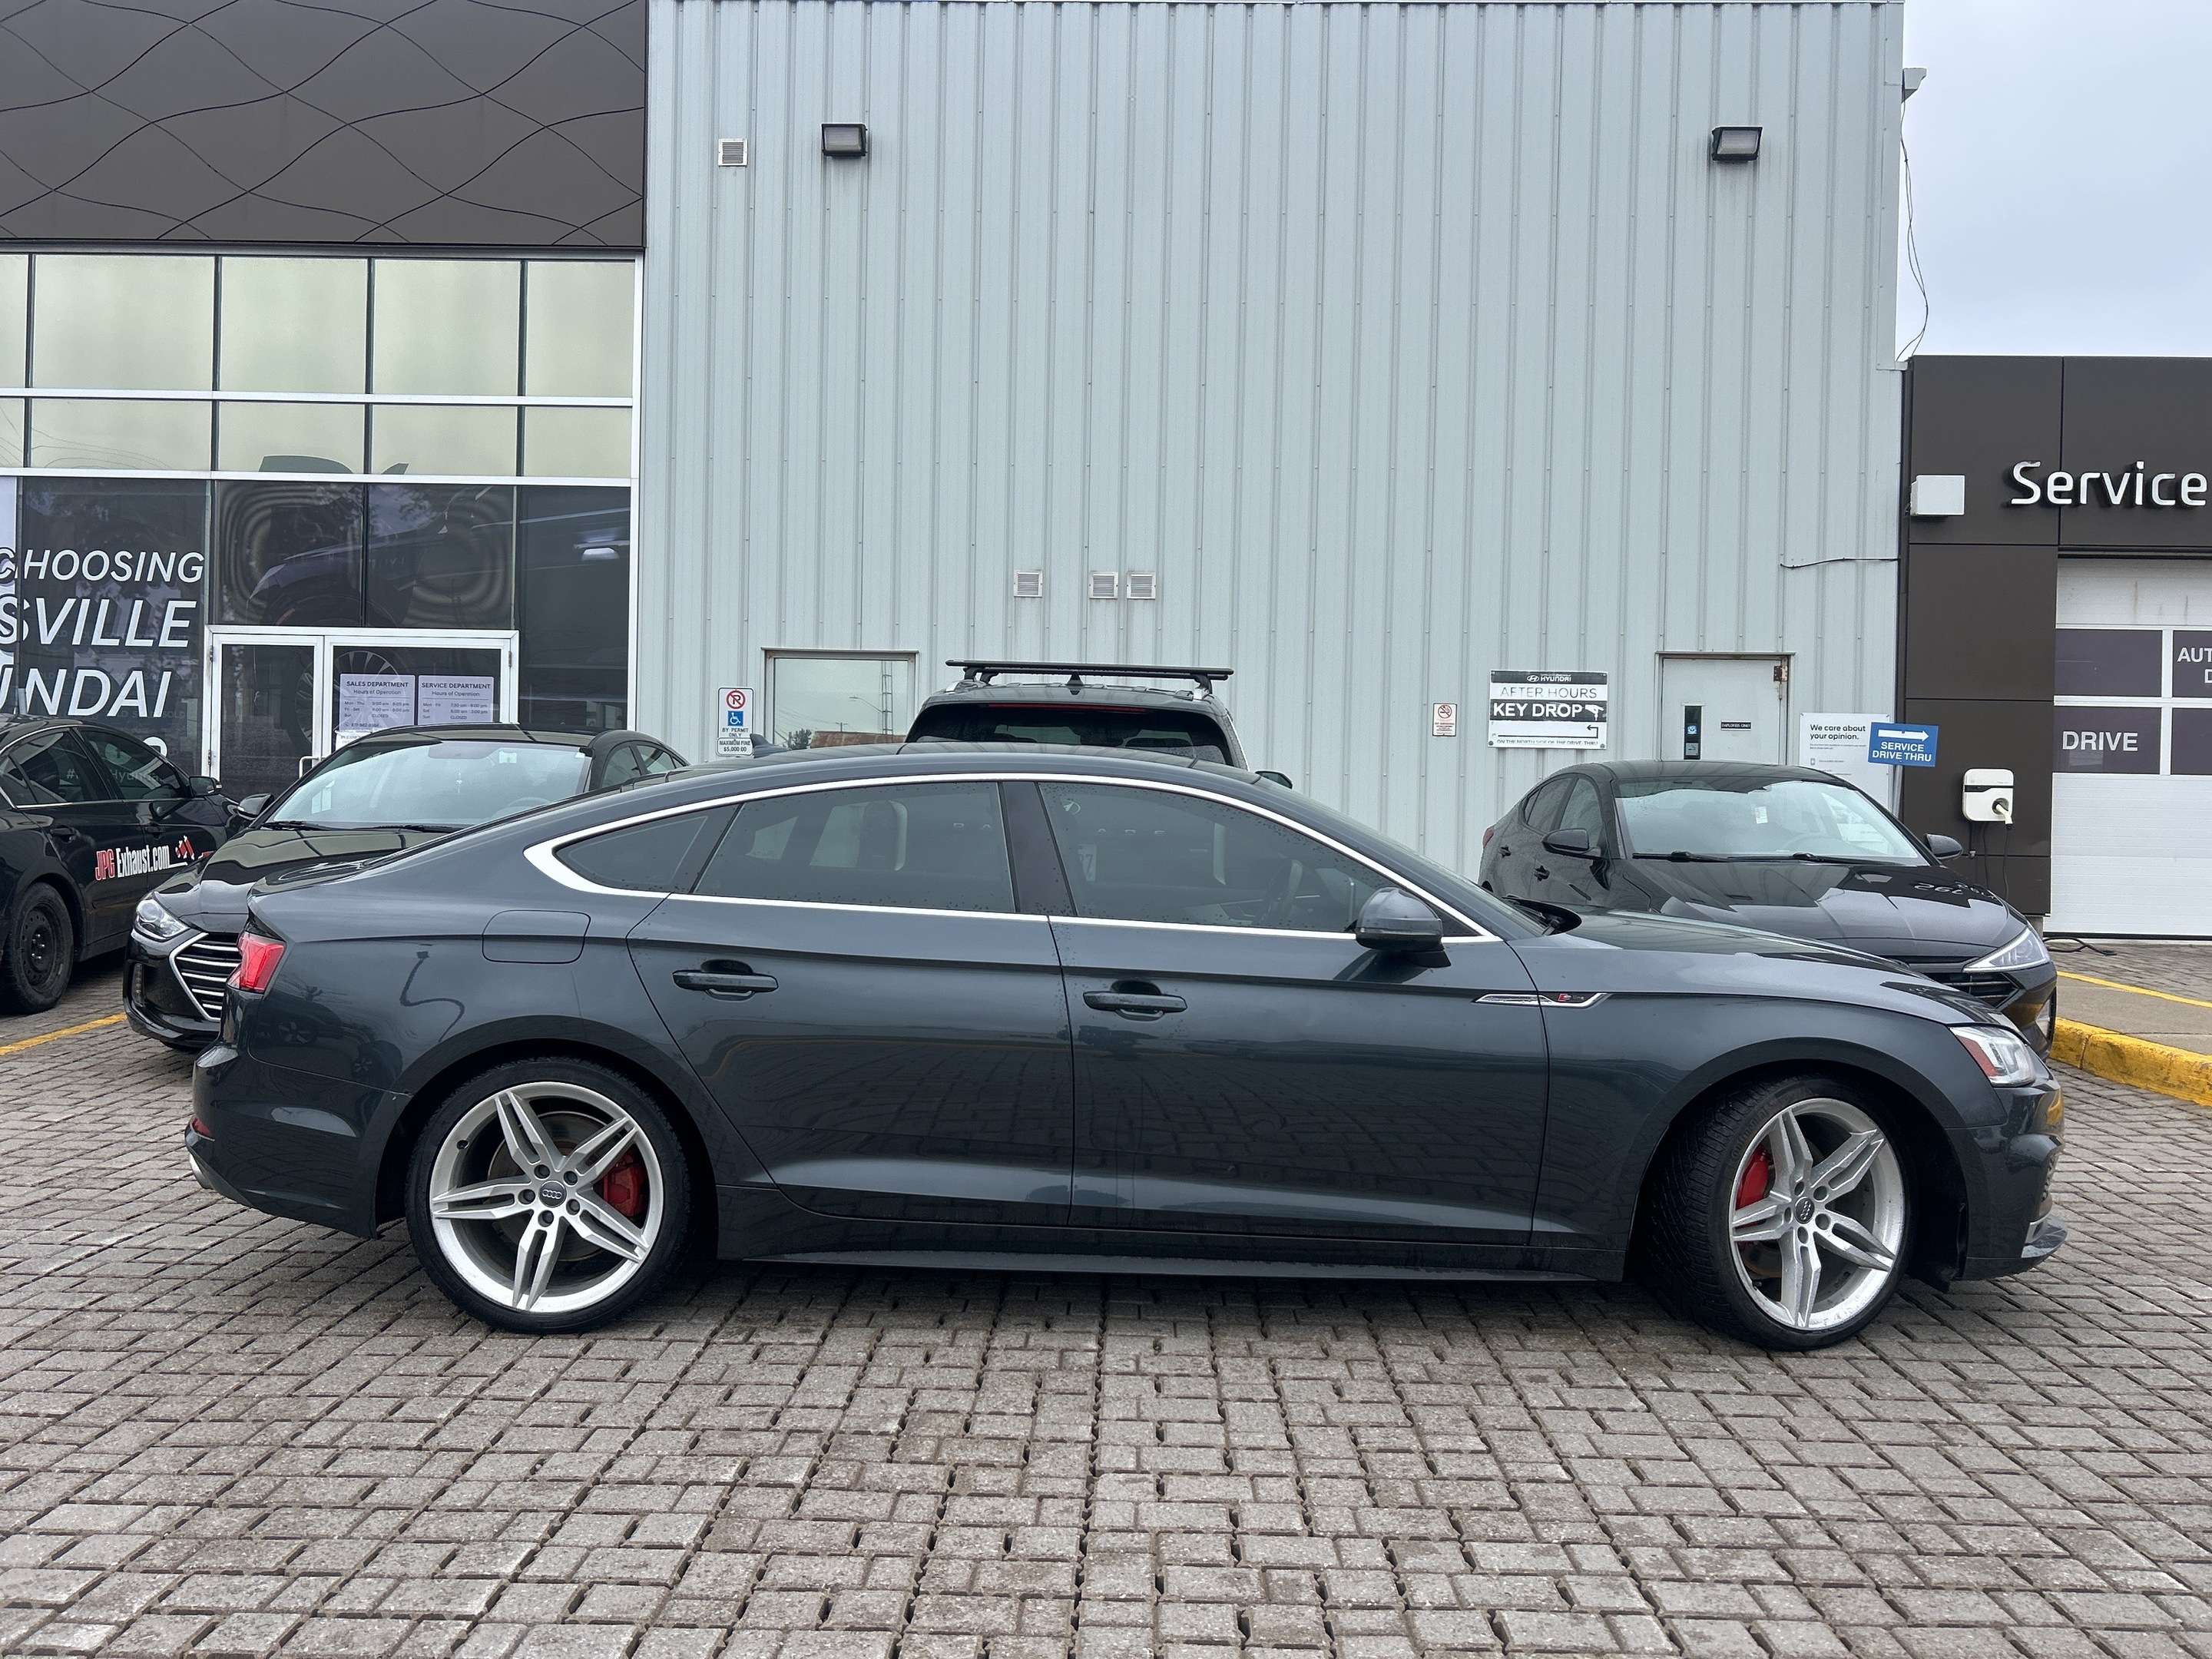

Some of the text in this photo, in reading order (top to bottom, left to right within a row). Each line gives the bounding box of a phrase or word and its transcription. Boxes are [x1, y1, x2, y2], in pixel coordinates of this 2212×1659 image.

[2010, 460, 2208, 506] Service
[1499, 687, 1597, 699] AFTER HOURS
[1493, 702, 1583, 718] KEY DROP
[1829, 733, 1859, 741] opinion.
[2061, 730, 2139, 752] DRIVE
[1880, 741, 1925, 752] SERVICE
[1872, 750, 1932, 762] DRIVE THRU
[116, 845, 171, 879] Exhaust.com
